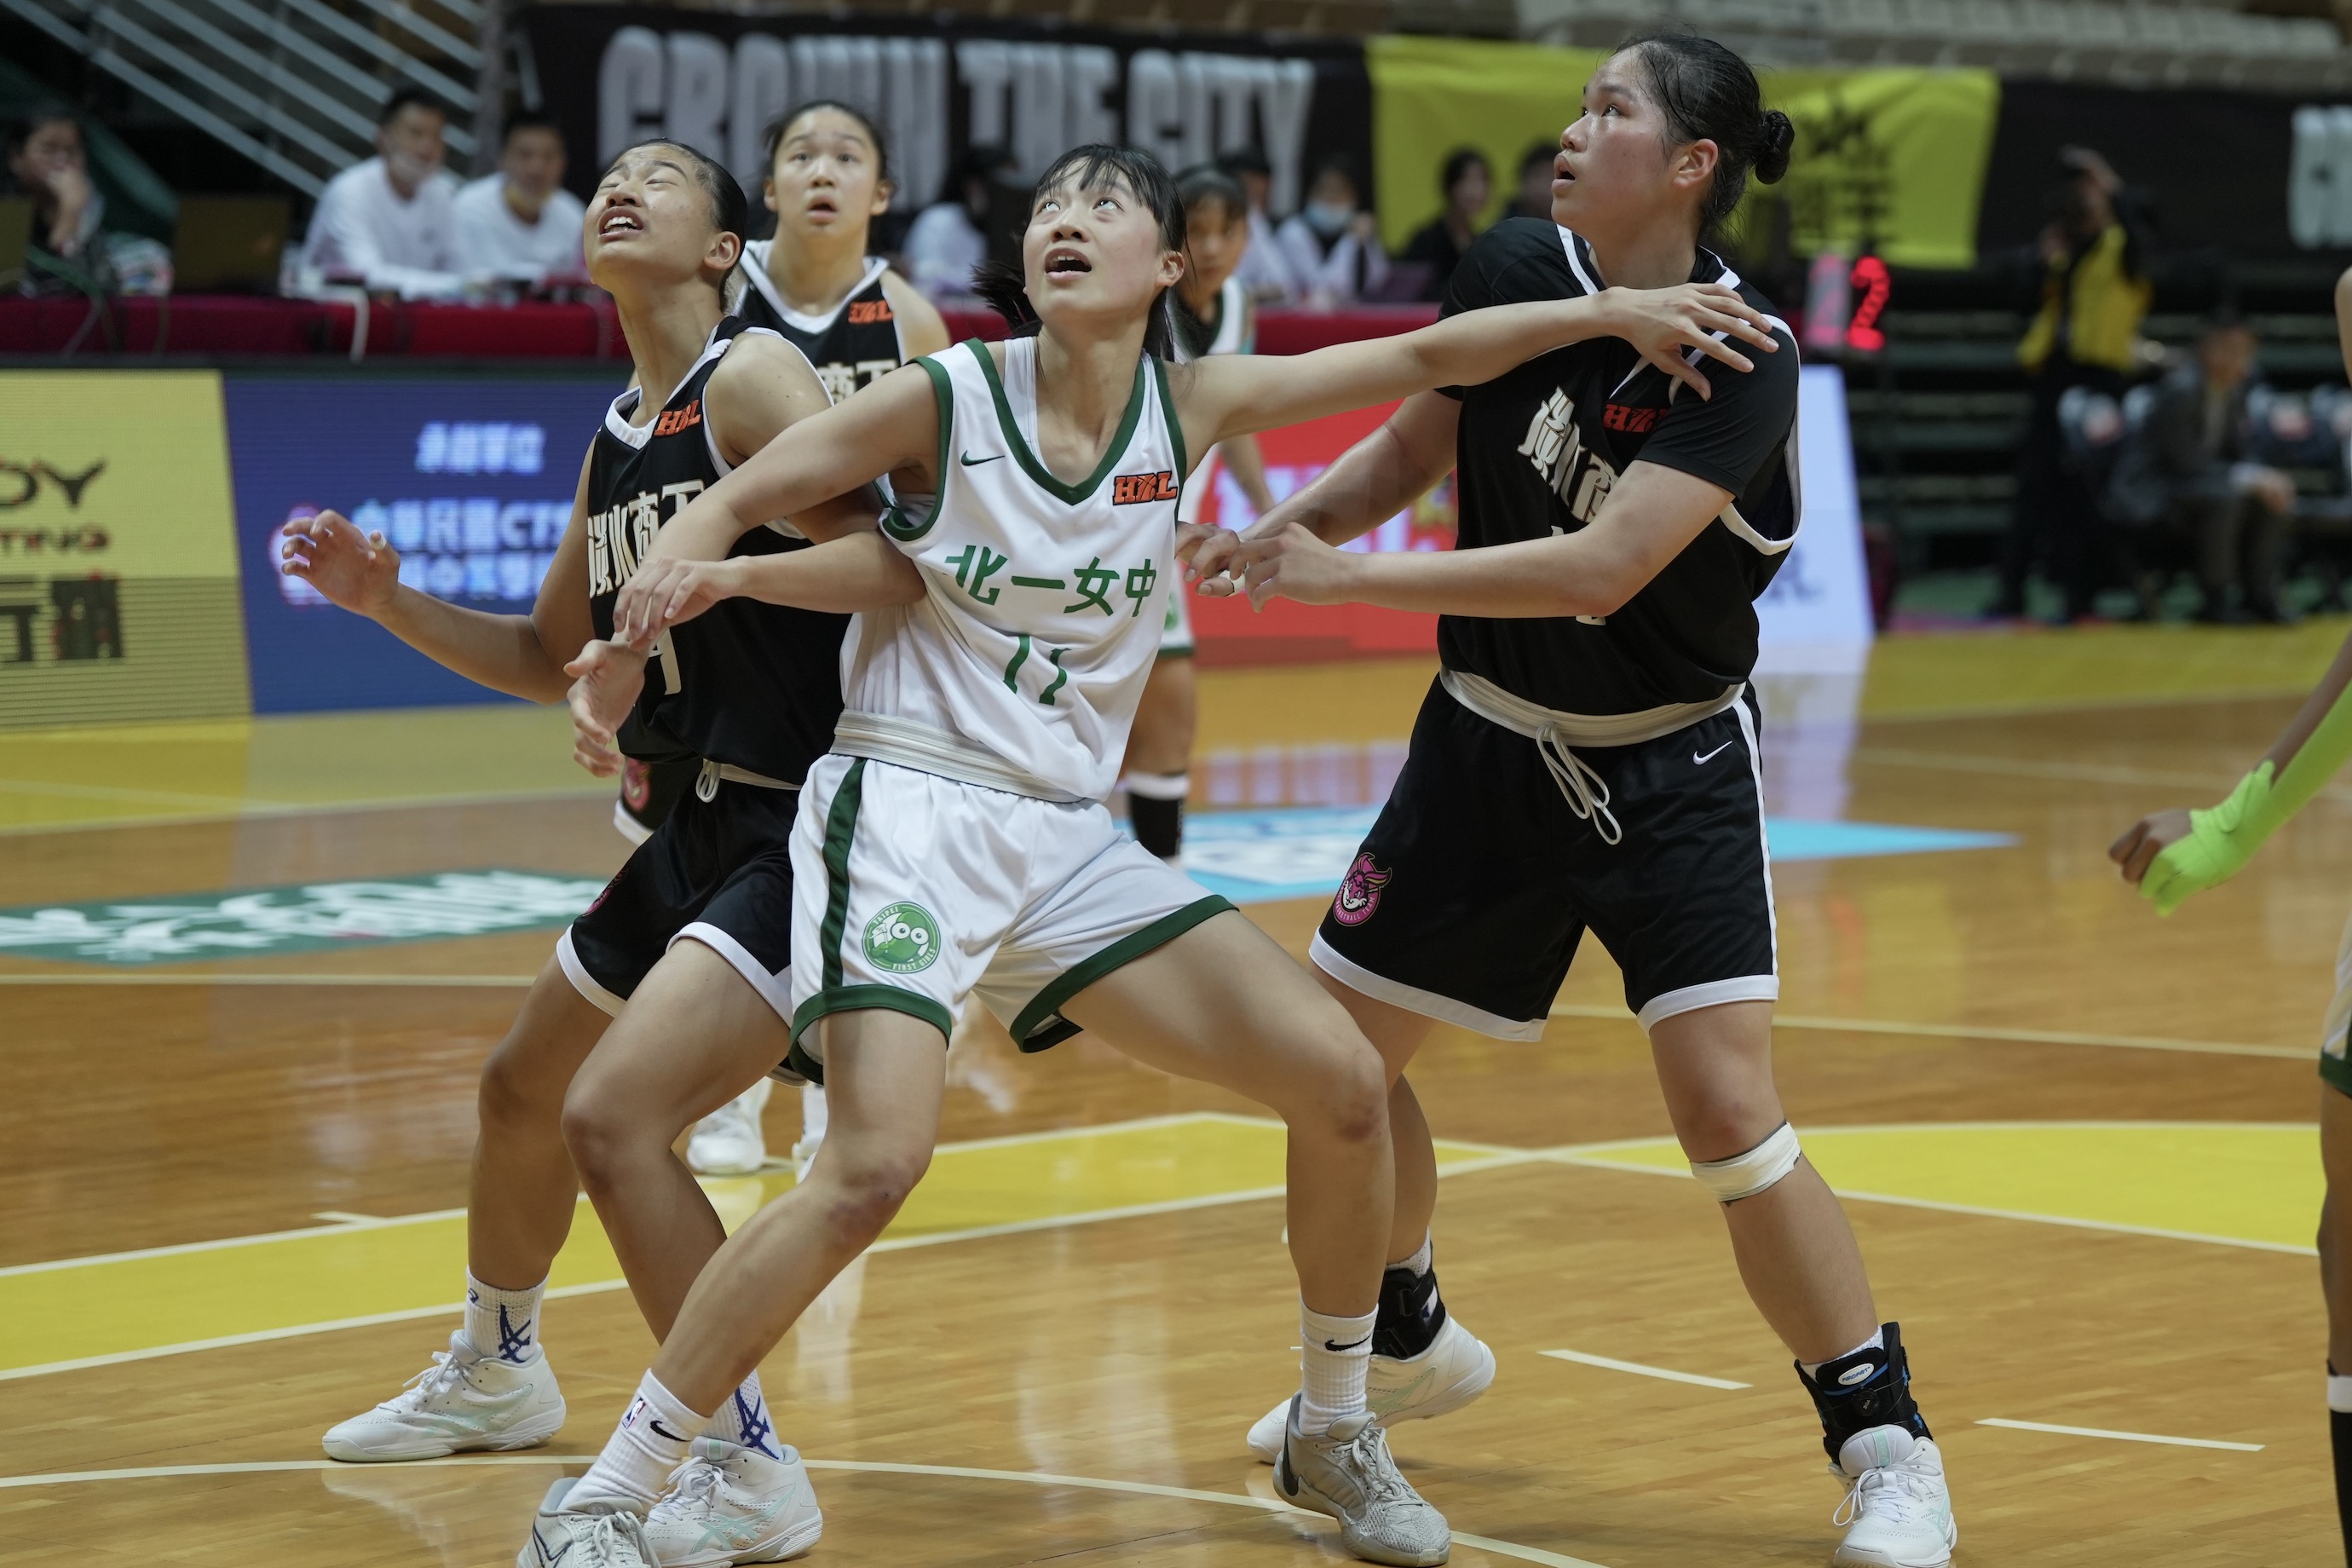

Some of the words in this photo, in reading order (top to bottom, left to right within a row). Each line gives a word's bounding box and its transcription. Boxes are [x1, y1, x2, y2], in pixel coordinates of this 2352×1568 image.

[956, 40, 1118, 181] THE
[1128, 49, 1315, 215] CITY
[654, 400, 702, 437] HBL
[1602, 402, 1669, 433] HB
[1113, 470, 1179, 505] HBL
[944, 545, 1157, 618] 北一女中
[1003, 634, 1073, 706] 11
[872, 906, 899, 925] TAIPEI
[1362, 896, 1375, 915] TEAM
[919, 948, 937, 967] GIRLS
